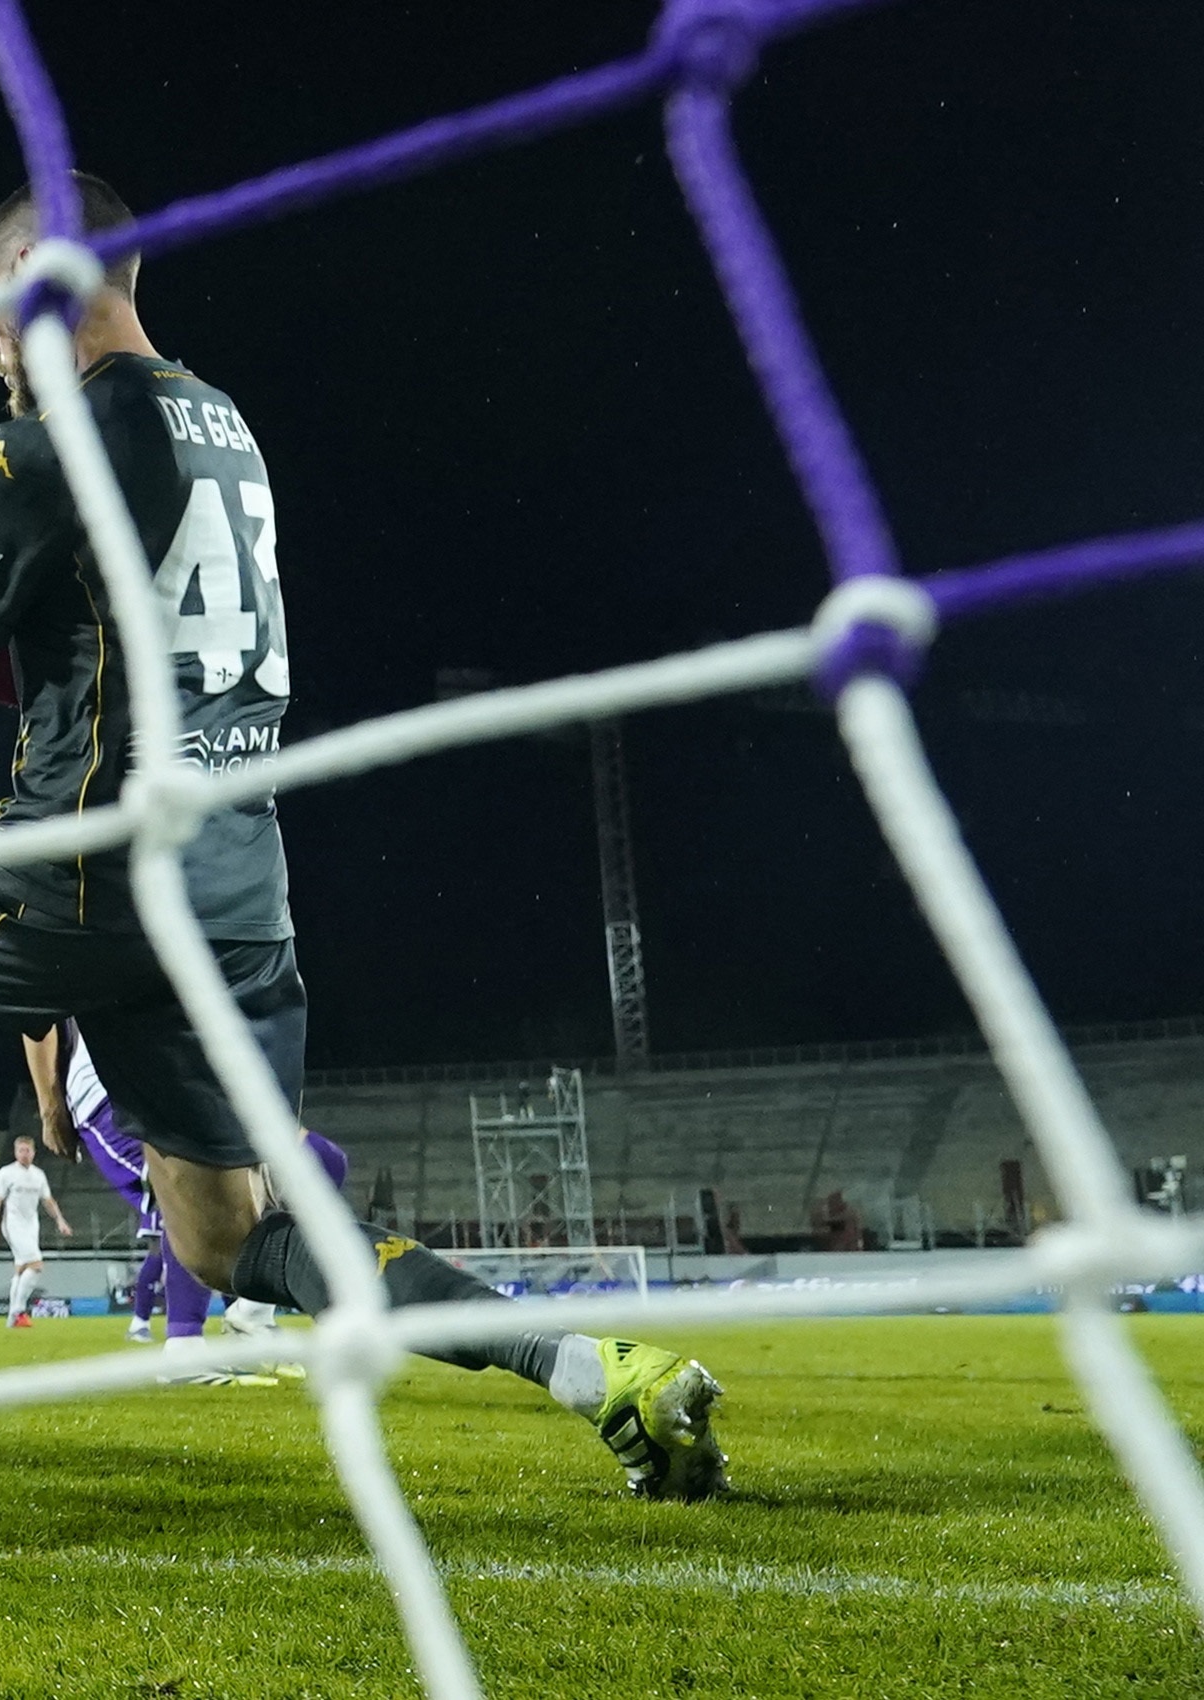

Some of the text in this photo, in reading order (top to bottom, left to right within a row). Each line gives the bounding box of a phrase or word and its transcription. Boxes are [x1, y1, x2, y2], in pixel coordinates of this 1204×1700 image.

[156, 395, 260, 456] DE GEA
[153, 478, 290, 697] 43
